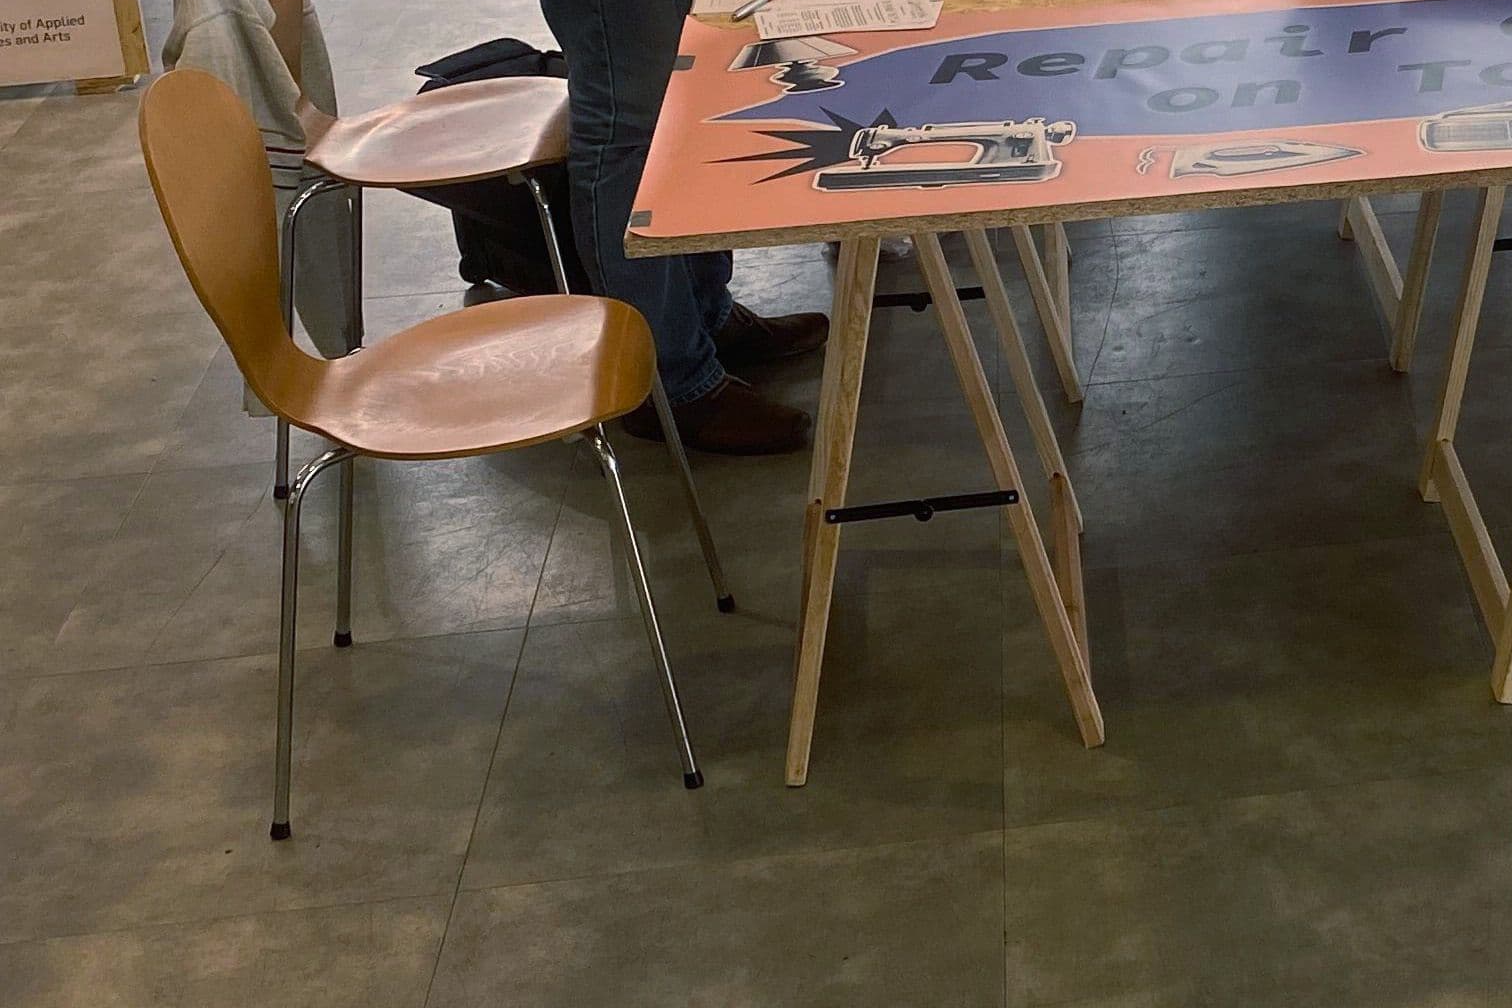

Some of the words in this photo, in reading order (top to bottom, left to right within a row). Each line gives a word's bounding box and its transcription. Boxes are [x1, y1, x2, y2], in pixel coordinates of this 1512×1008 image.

[20, 19, 31, 31] of
[36, 15, 85, 30] Applied
[15, 33, 39, 46] and
[43, 32, 71, 43] Arts
[929, 28, 1407, 84] Repair
[1147, 80, 1301, 113] on
